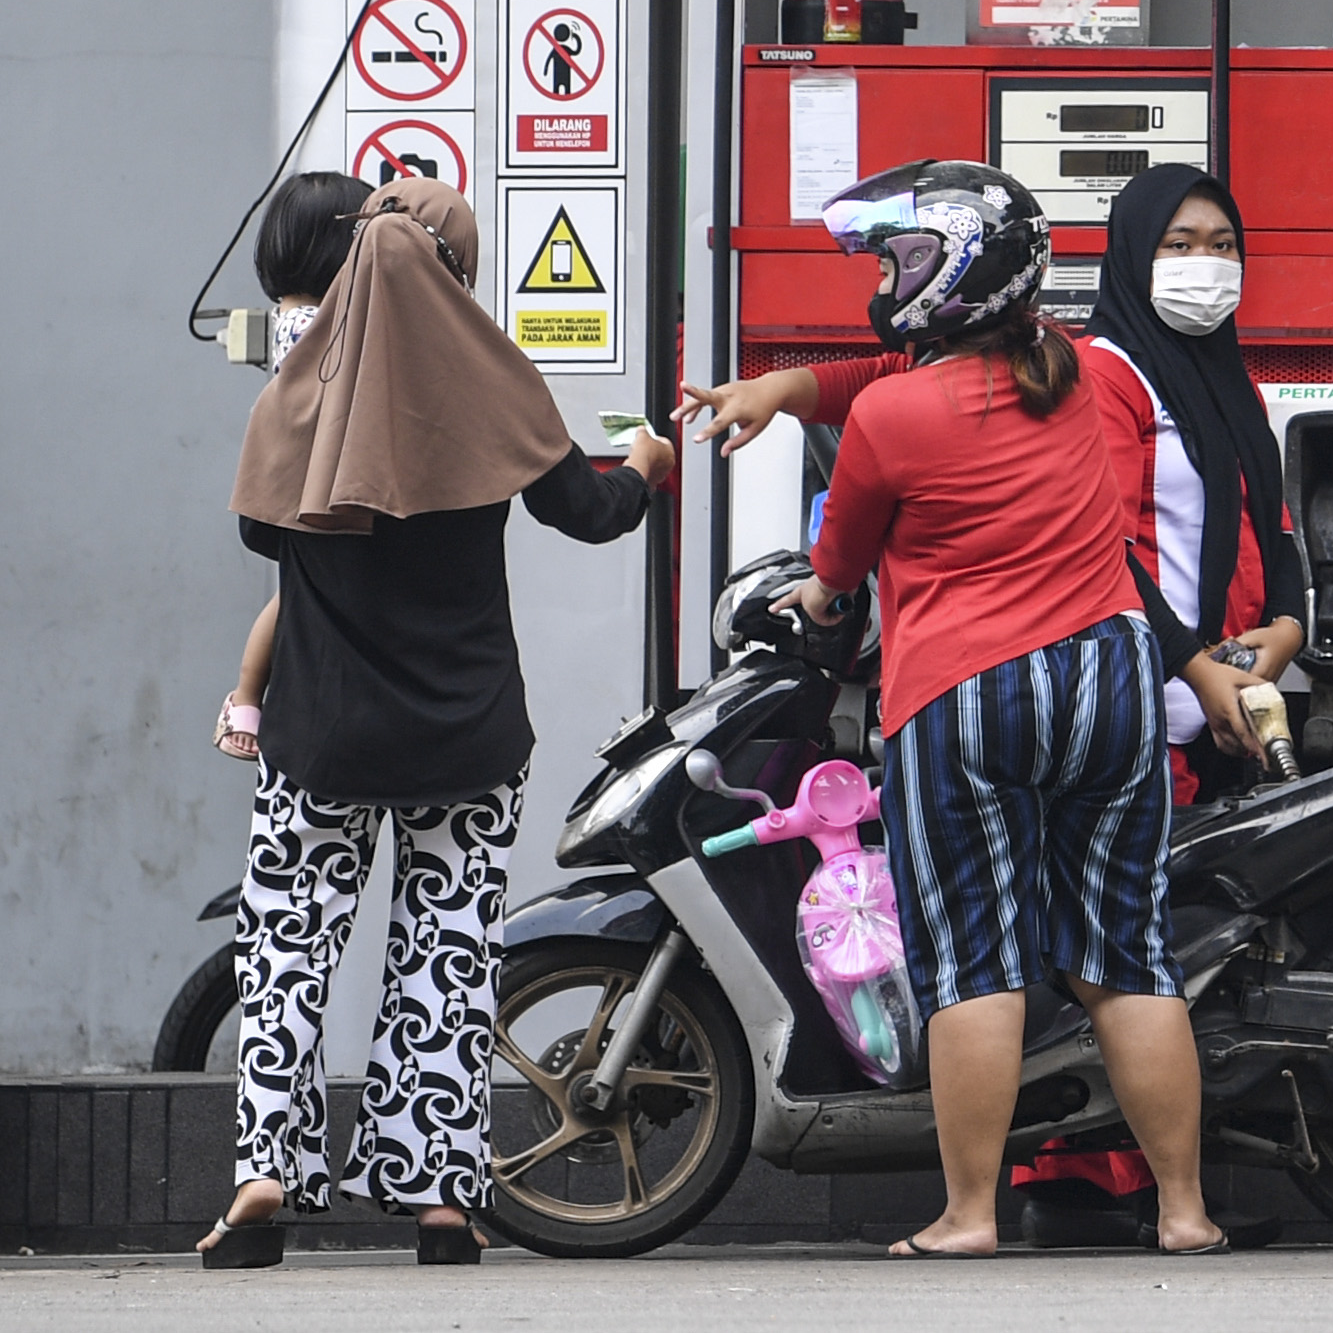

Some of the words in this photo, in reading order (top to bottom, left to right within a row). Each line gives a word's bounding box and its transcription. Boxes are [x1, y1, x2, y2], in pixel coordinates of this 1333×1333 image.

[760, 50, 813, 60] TATSUNO
[1046, 112, 1058, 120] Rp
[533, 118, 591, 131] DILARANG
[521, 333, 543, 342] PADA
[546, 333, 574, 342] JARAK
[576, 333, 601, 342] AMAN
